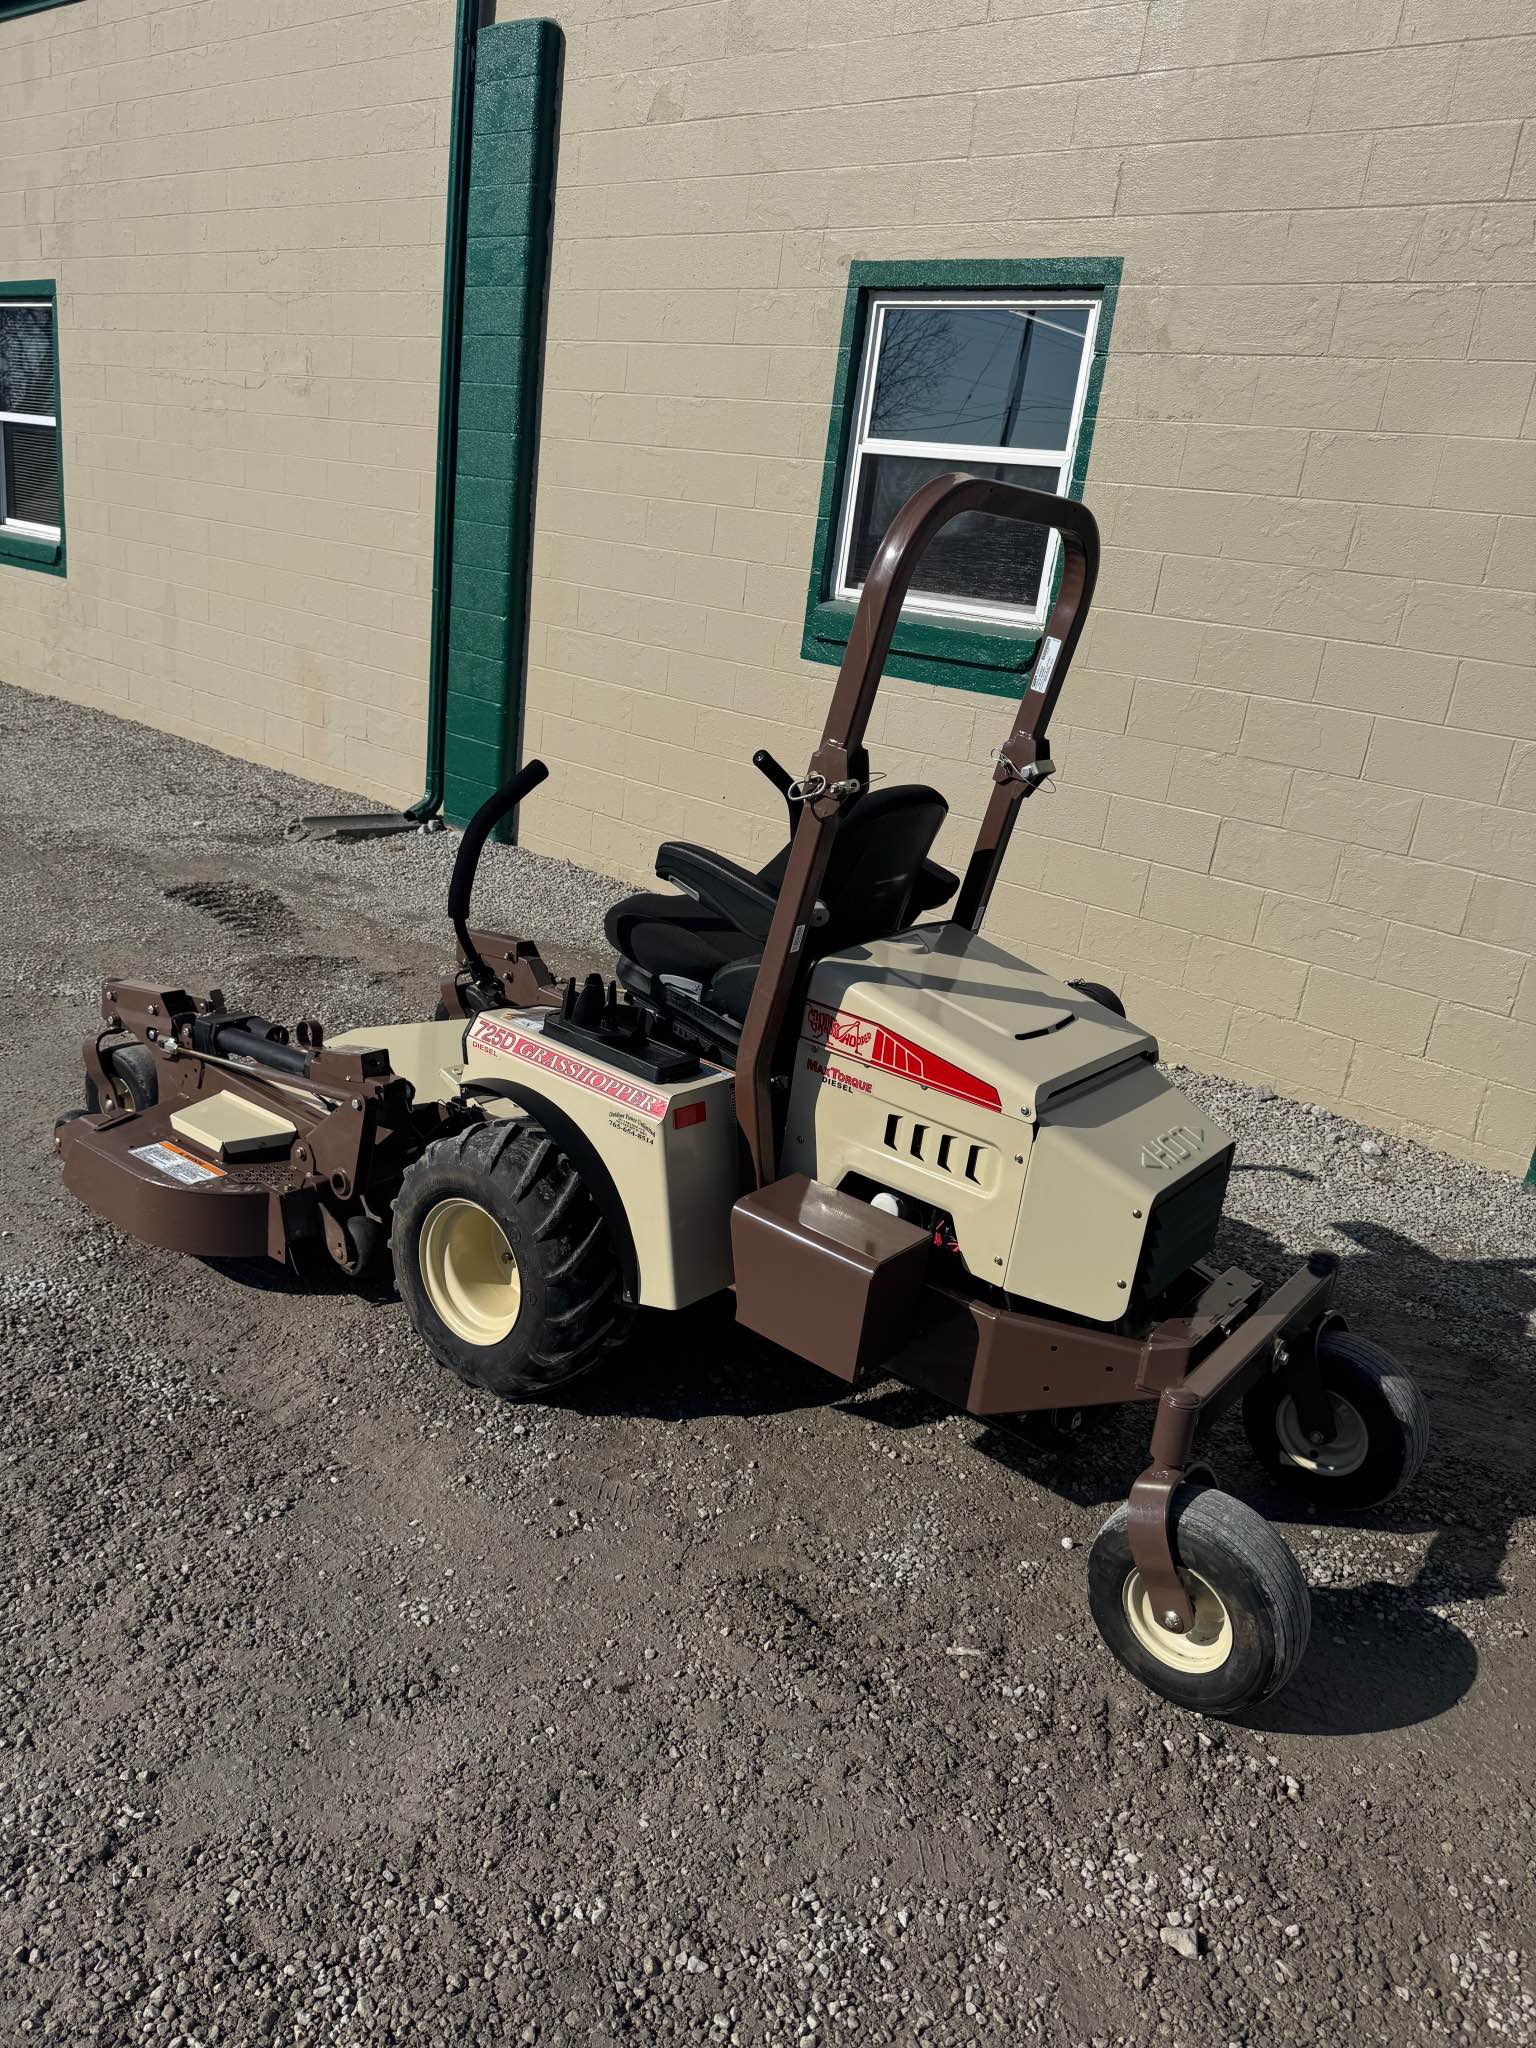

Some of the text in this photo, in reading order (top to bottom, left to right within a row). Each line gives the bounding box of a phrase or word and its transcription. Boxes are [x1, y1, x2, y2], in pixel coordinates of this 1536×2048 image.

[472, 1041, 498, 1057] DIESEL
[474, 1020, 657, 1112] 725D GRASSHOPPER
[822, 1076, 854, 1093] DIESEL
[1142, 1125, 1200, 1170] HOT
